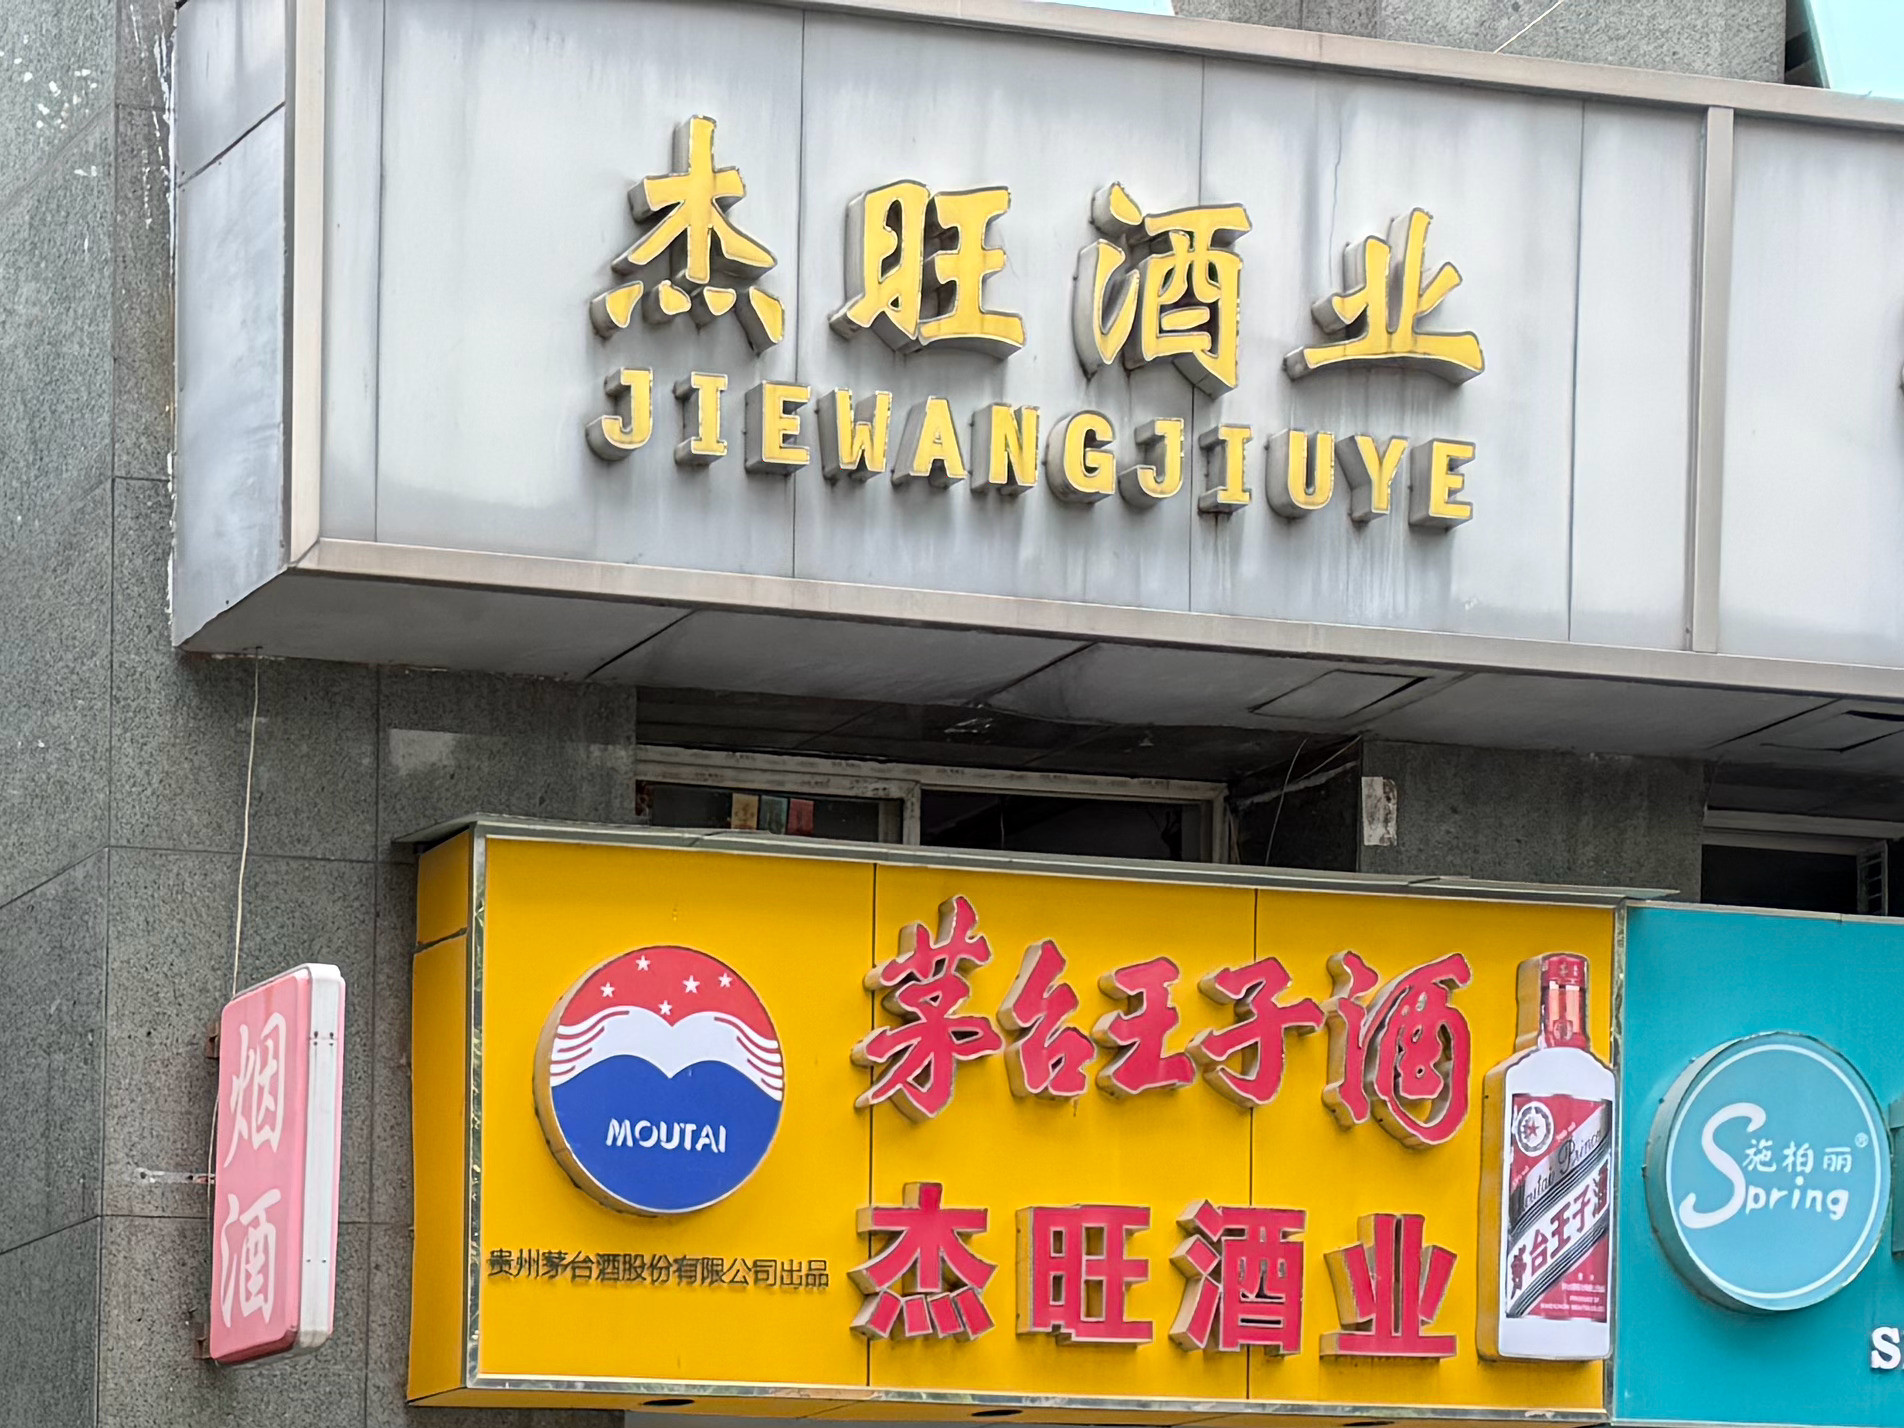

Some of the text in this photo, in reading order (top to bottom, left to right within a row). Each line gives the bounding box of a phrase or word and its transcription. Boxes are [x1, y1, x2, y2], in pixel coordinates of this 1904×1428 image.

[594, 115, 1484, 392] 杰旺酒业
[589, 367, 1475, 527] JIEWANGJIUYE
[852, 895, 1473, 1148] 茅台王子酒
[221, 1011, 287, 1328] 烟酒
[605, 1118, 727, 1153] MOUTAI
[1678, 1102, 1849, 1229] Spring
[487, 1248, 830, 1289] 贵州茅台酒股份有限公司出品
[848, 1181, 1458, 1359] 杰旺酒业
[1870, 1325, 1904, 1371] S
